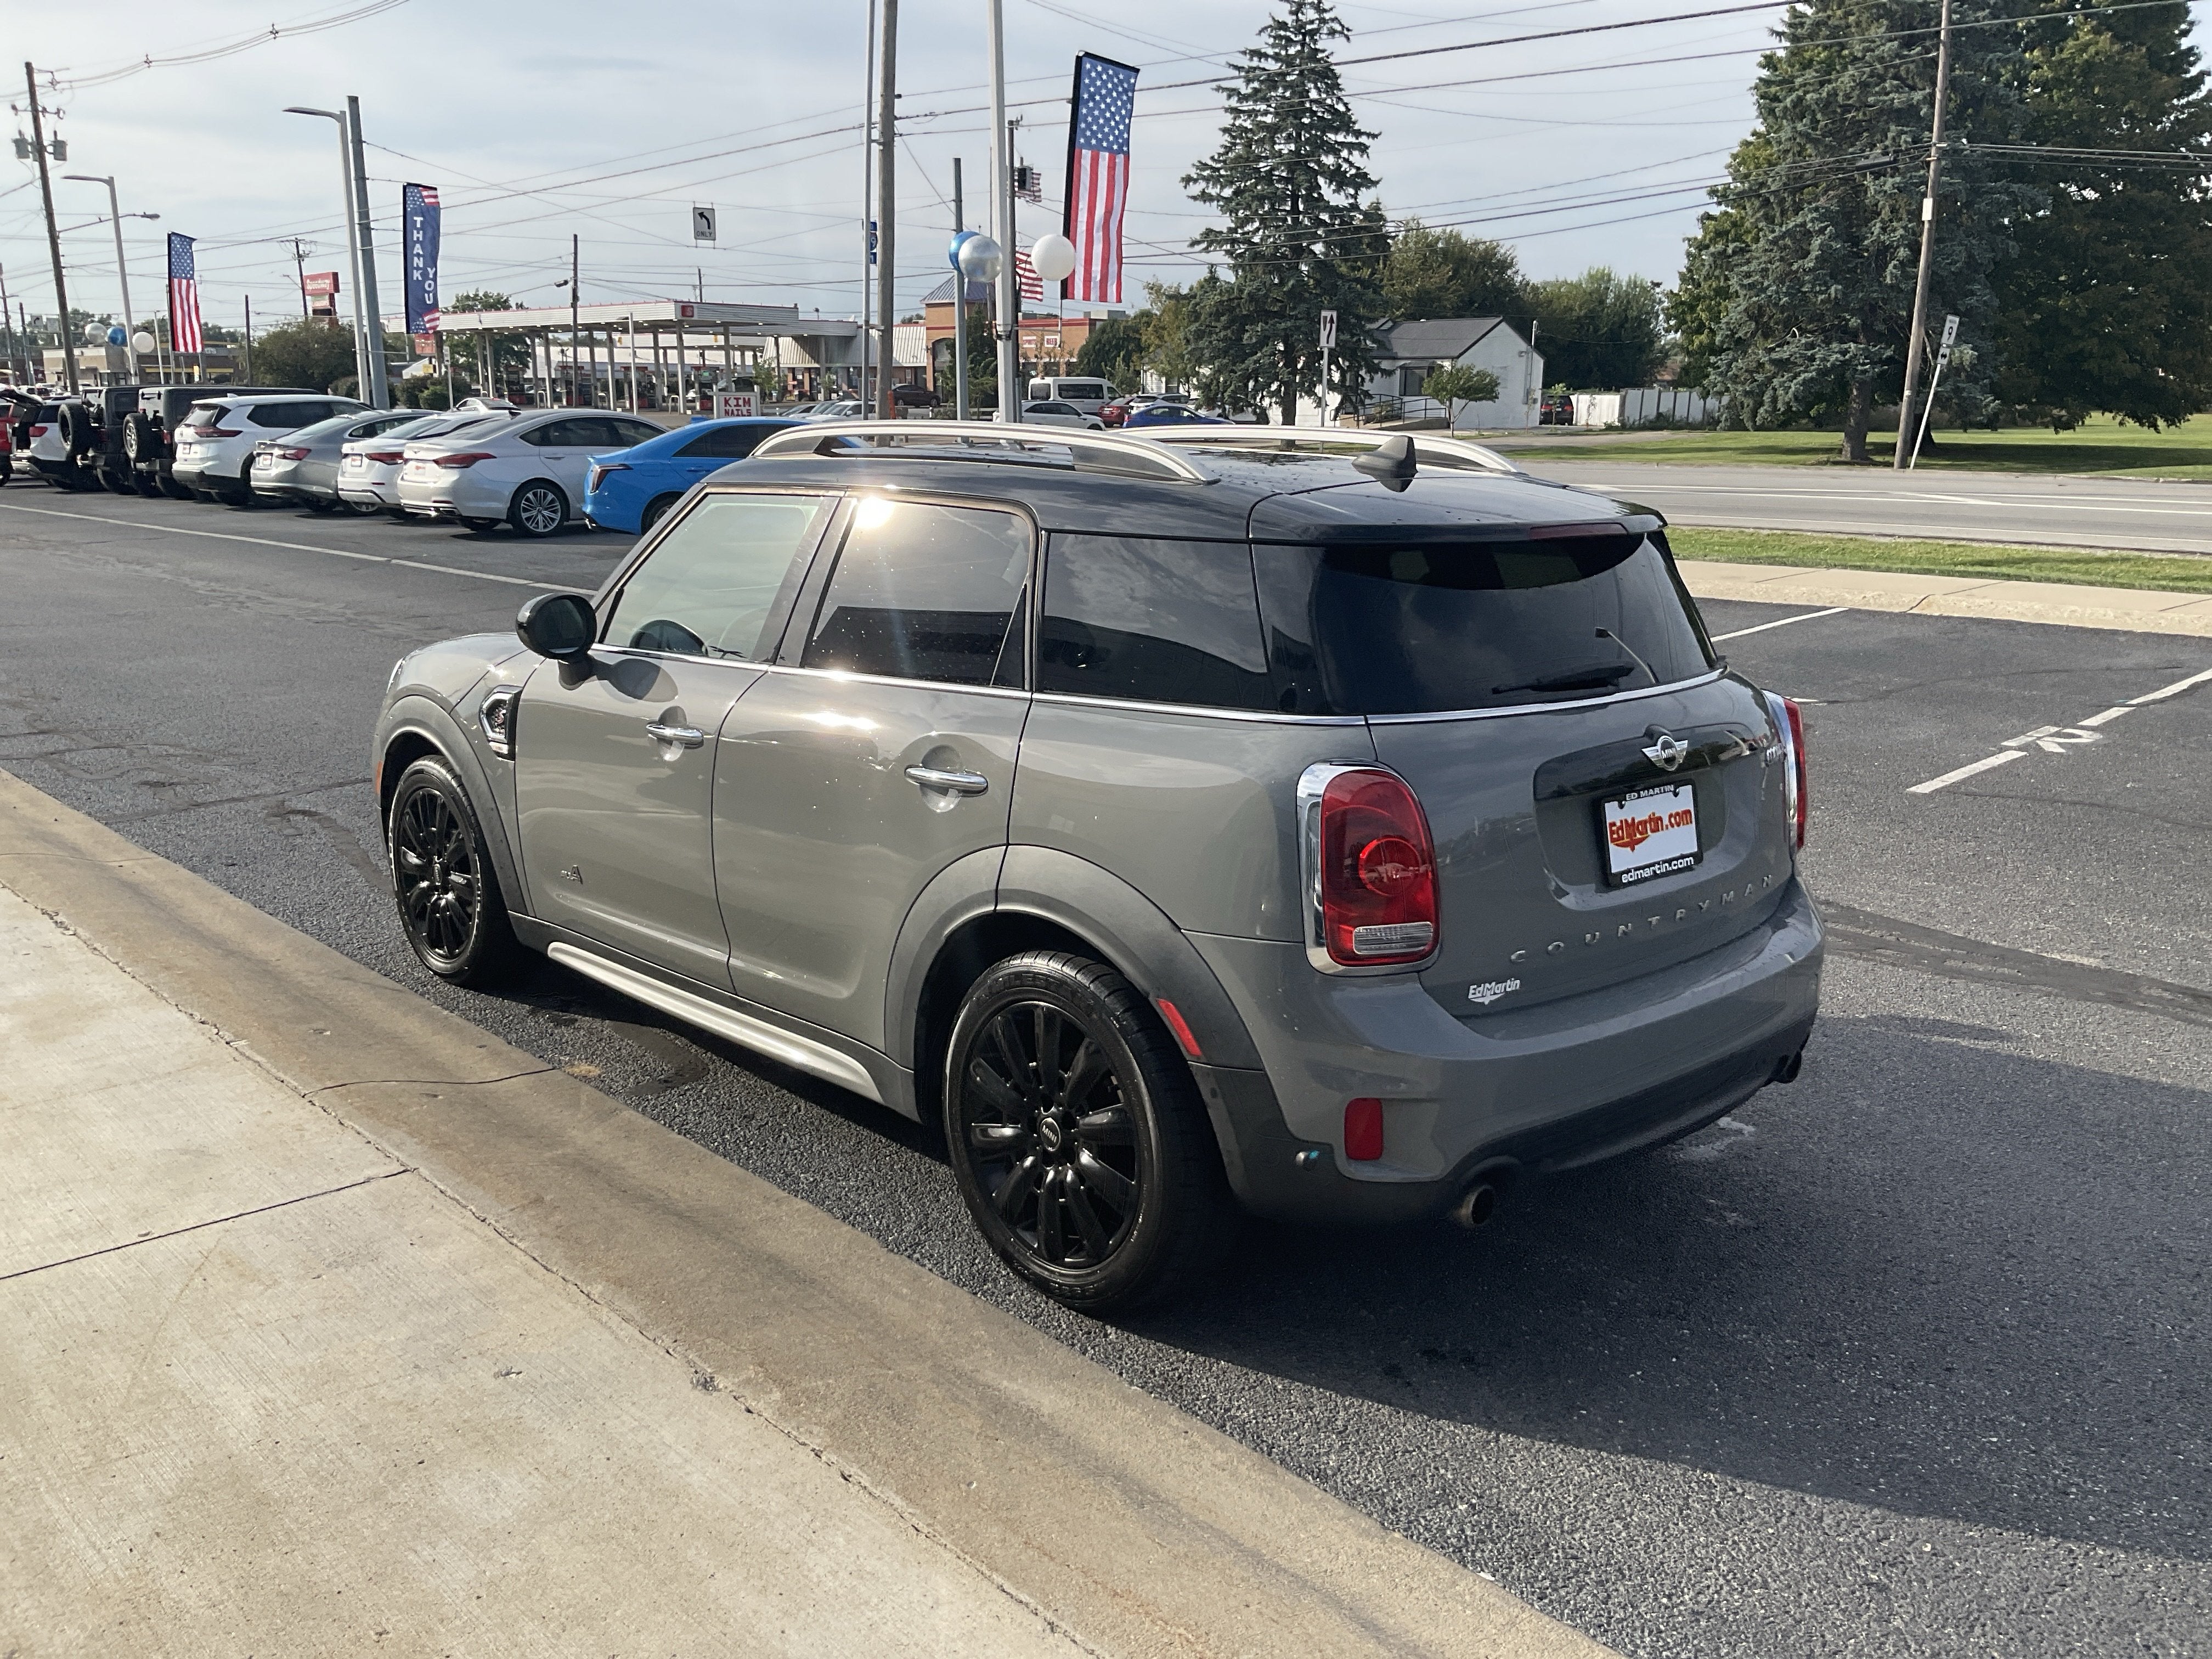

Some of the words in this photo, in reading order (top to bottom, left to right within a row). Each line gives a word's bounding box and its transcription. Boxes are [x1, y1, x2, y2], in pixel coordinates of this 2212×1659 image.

[413, 217, 423, 280] THANK
[425, 267, 436, 304] YOU
[724, 397, 752, 408] KIM
[724, 408, 752, 417] NAILS
[1661, 747, 1677, 759] MINI
[1626, 792, 1638, 801] ED
[1640, 785, 1674, 798] MARTIN
[1608, 809, 1693, 844] EdMartin.com
[1621, 856, 1694, 883] edmartin.com
[1510, 874, 1772, 962] COUNTRYMAN
[1468, 978, 1521, 999] EdMartin
[1042, 1124, 1058, 1143] MINI
